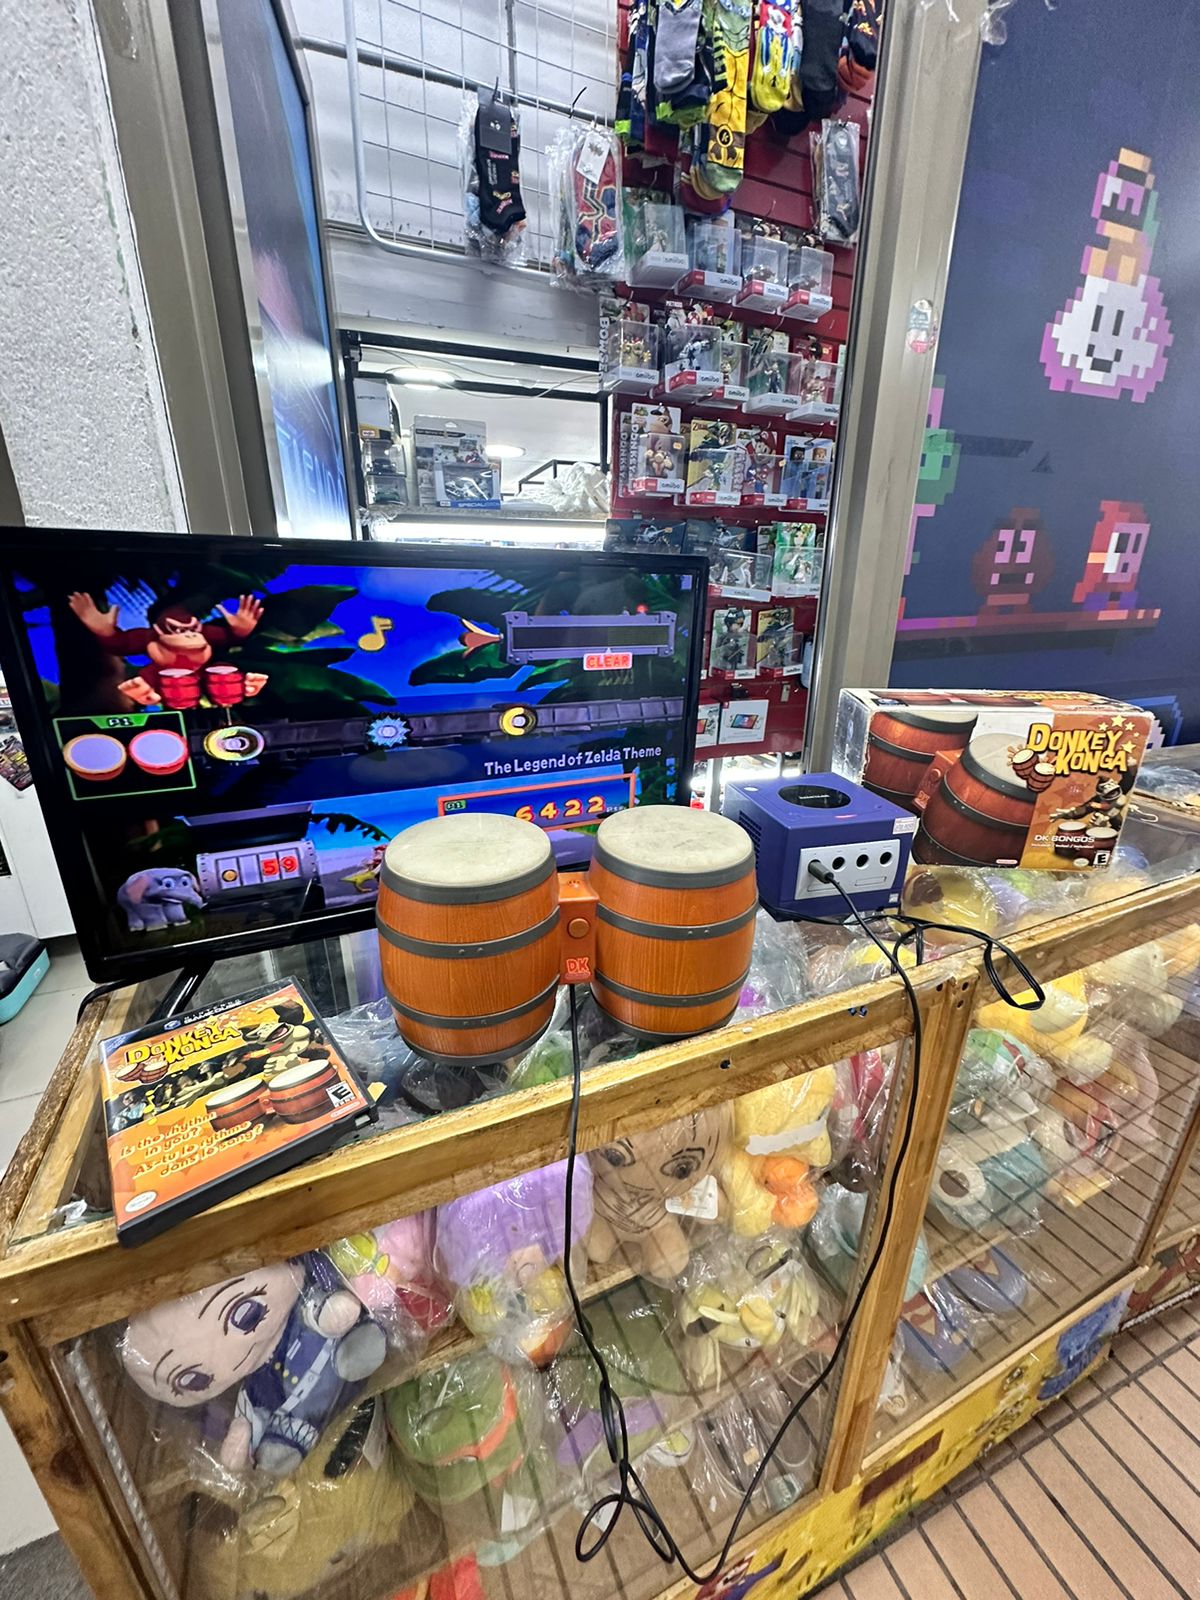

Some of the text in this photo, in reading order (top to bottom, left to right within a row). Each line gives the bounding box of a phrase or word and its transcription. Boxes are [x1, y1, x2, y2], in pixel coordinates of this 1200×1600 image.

[586, 655, 630, 670] CLEAR
[108, 717, 132, 727] P1
[1026, 722, 1123, 754] DONKEY
[484, 745, 662, 775] The Legend of Zelda Theme
[1054, 749, 1127, 776] KONGA
[515, 796, 606, 822] 6422
[1034, 834, 1095, 843] DK BONGOS
[261, 855, 298, 876] 59
[566, 956, 590, 975] DK
[125, 1022, 221, 1064] DONKEY
[164, 1025, 242, 1065] KONGA
[331, 1085, 352, 1101] E
[137, 1133, 165, 1150] the
[166, 1111, 218, 1138] rhythm
[144, 1125, 202, 1159] in you?
[133, 1120, 253, 1180] As-tu le rythme
[160, 1123, 264, 1178] dans le sang?
